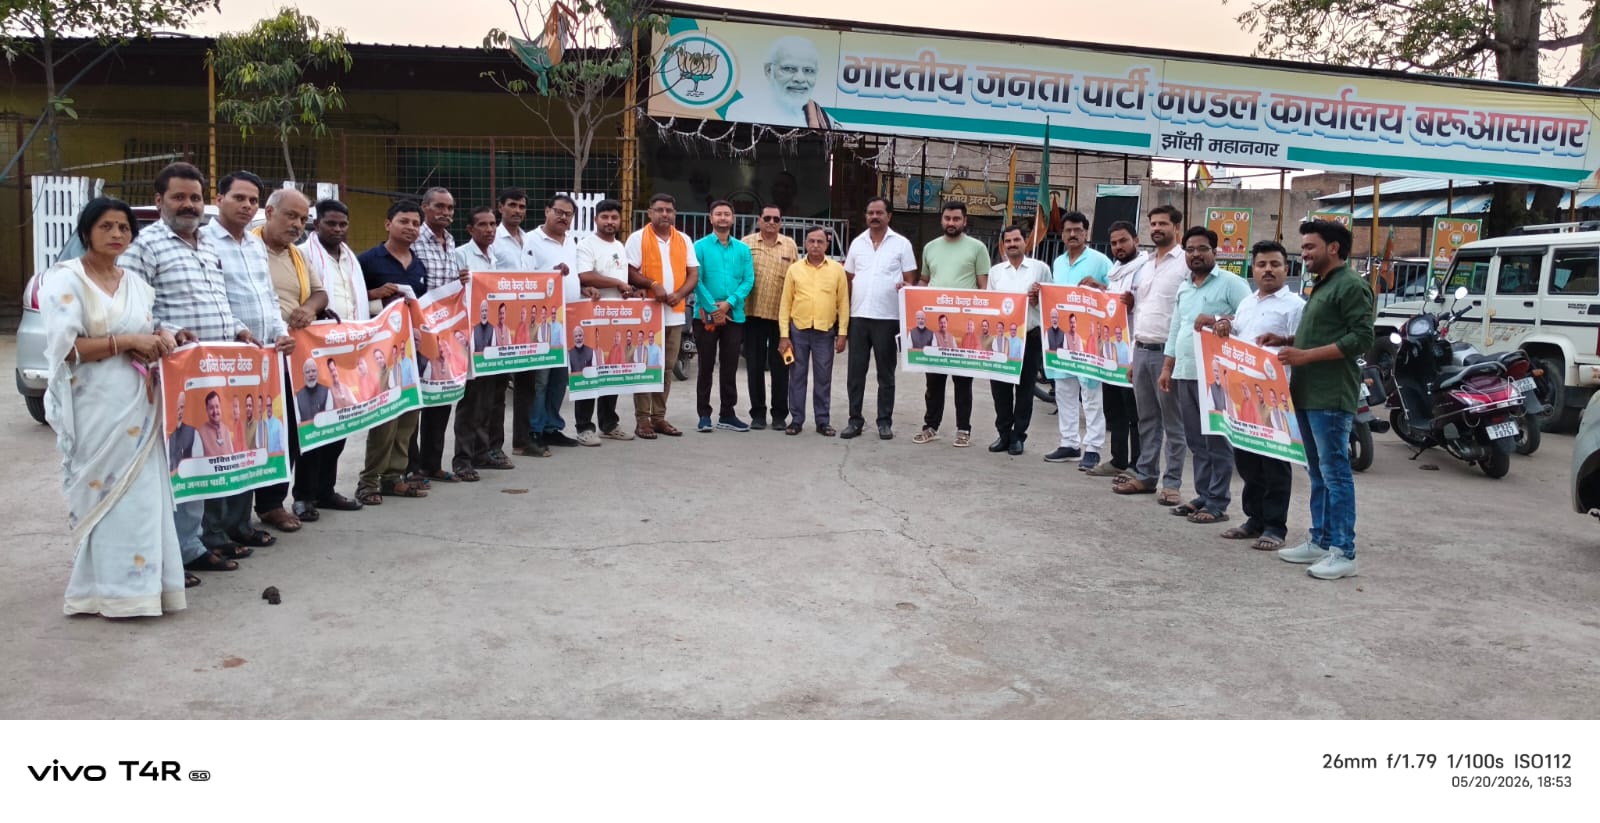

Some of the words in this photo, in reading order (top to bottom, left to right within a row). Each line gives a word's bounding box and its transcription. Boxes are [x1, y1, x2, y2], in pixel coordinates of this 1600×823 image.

[842, 51, 966, 95] भारतीय
[976, 65, 1073, 105] जनता
[1083, 68, 1150, 111] पार्टी
[1157, 82, 1261, 121] मण्डल
[1269, 89, 1406, 135] कार्यालय
[1161, 130, 1203, 152] झाँसी
[1208, 138, 1280, 158] महानगर
